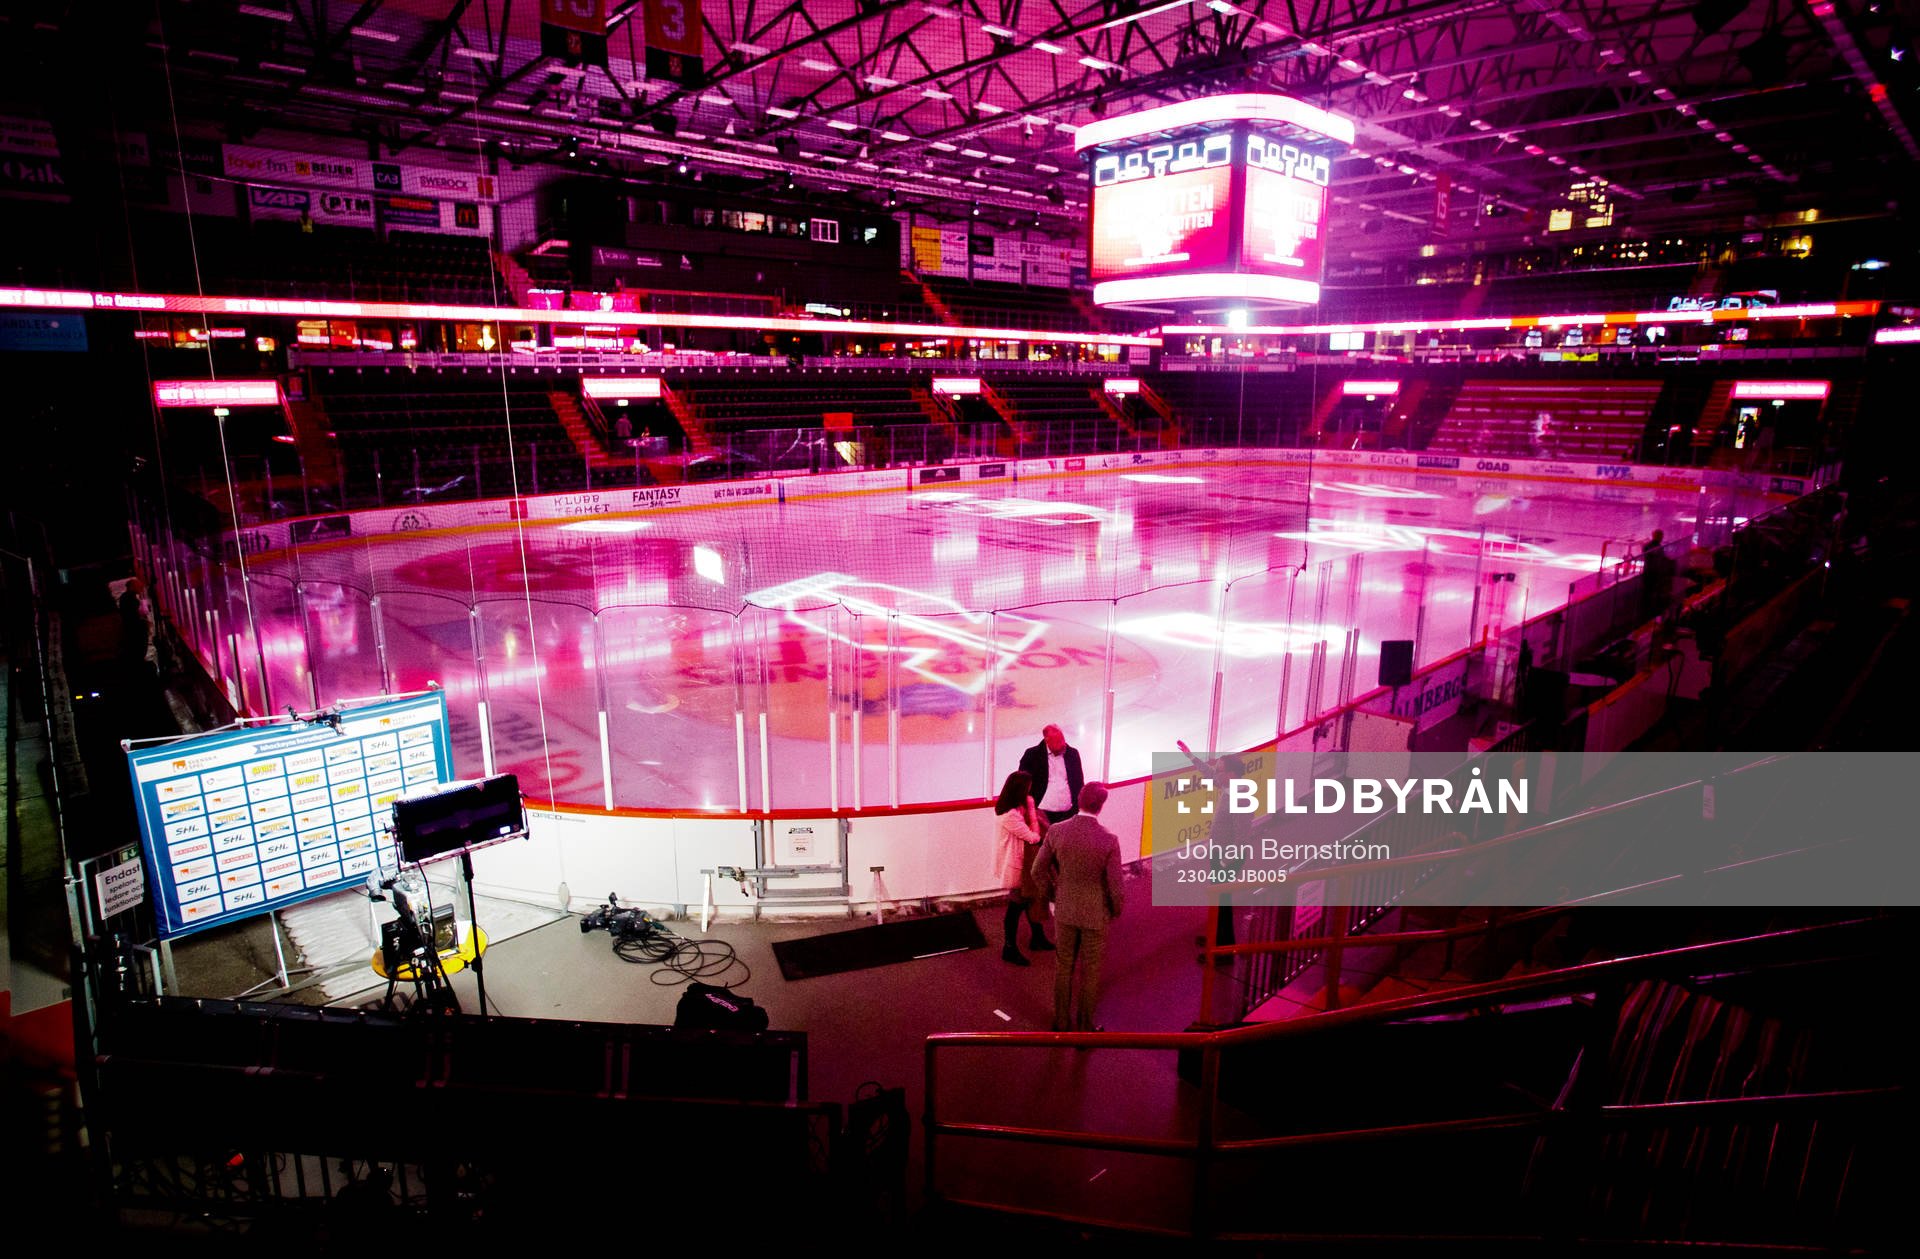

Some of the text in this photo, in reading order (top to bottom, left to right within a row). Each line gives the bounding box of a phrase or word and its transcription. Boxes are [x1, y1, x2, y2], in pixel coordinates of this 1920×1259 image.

[662, 1, 686, 40] 3
[311, 162, 353, 174] BEIJER
[420, 176, 468, 188] SWEROCK
[253, 191, 307, 207] VAP
[329, 196, 371, 211] PTM
[554, 494, 600, 506] KLUBB
[632, 488, 681, 502] FANTASY
[371, 741, 390, 750] SHL
[409, 751, 428, 760] SHL
[1163, 756, 1264, 800] Meken
[176, 824, 199, 836] SHL
[1177, 820, 1212, 843] 019-3
[223, 834, 245, 845] SHL
[268, 843, 289, 854] SHL
[310, 851, 331, 862] SHL
[352, 860, 371, 870] SHL
[105, 864, 140, 885] Endast
[187, 884, 211, 896] SHL
[234, 892, 256, 903] SHL
